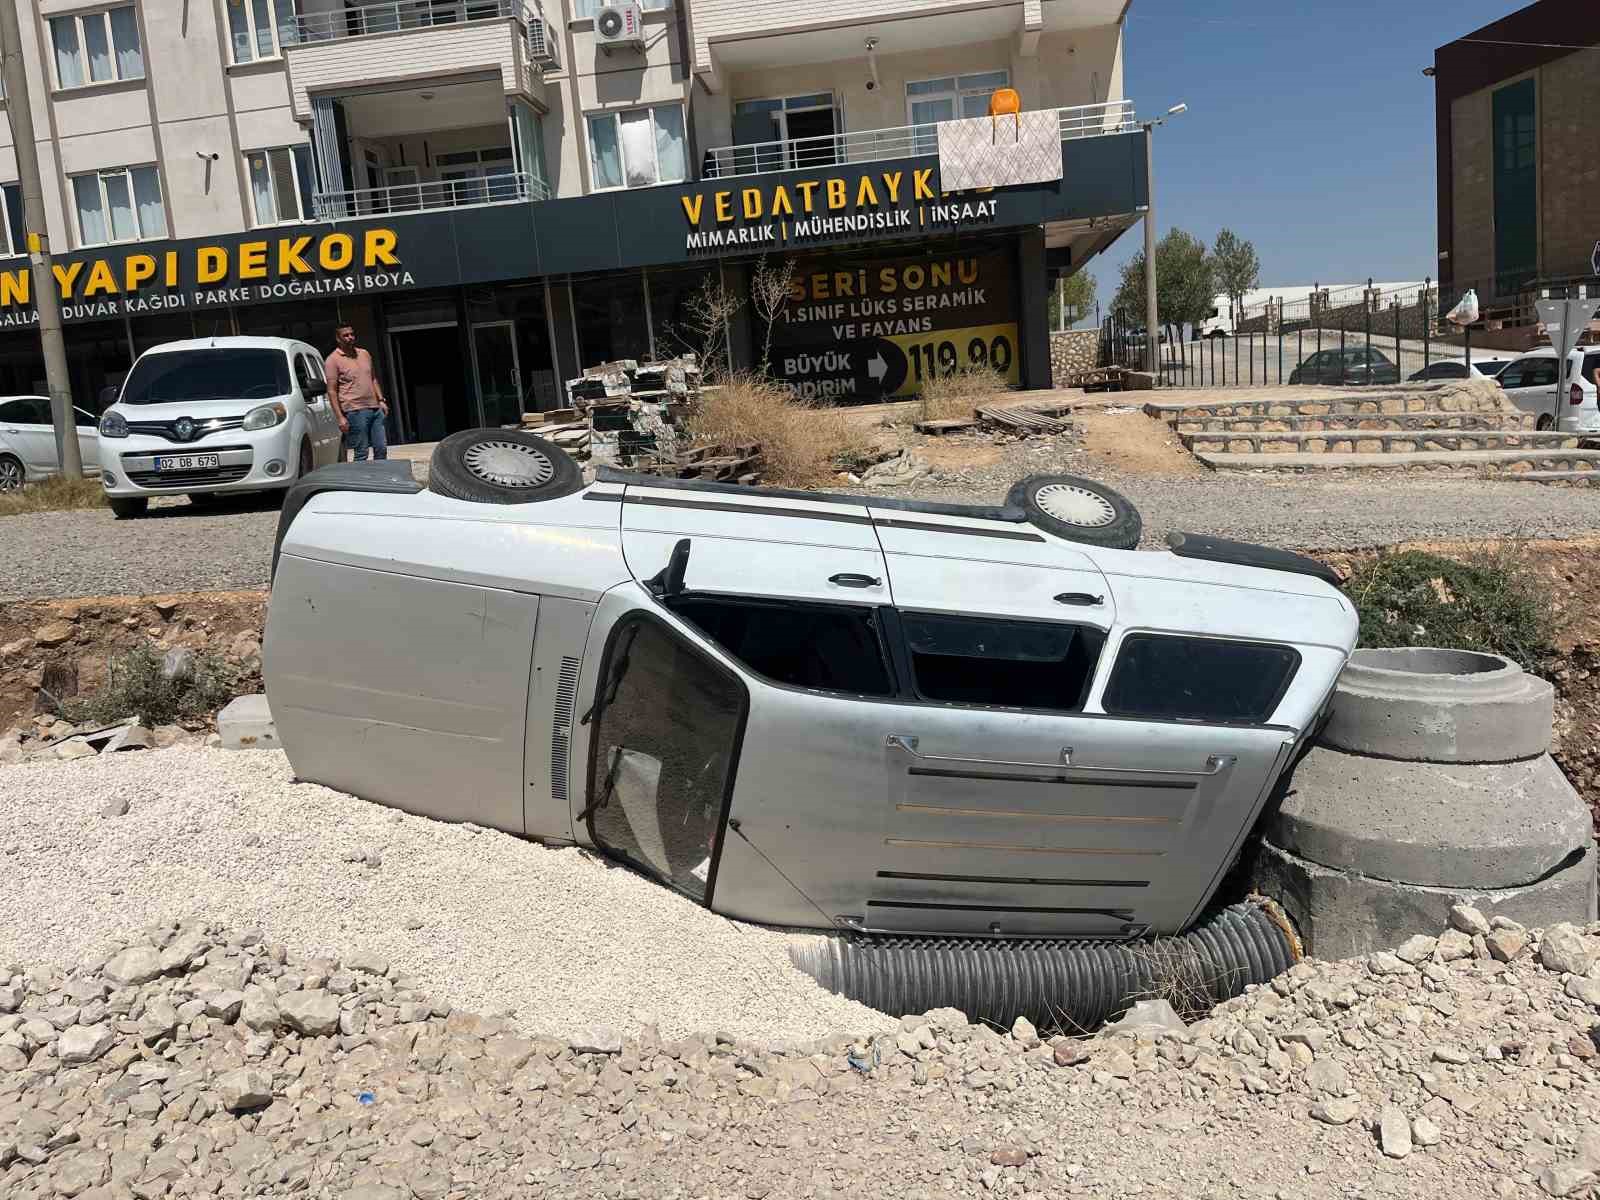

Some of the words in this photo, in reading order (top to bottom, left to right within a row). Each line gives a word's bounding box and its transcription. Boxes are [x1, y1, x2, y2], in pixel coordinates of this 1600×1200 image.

[681, 167, 993, 225] VEDATBAYK
[686, 224, 775, 249] MİMARLIK
[795, 209, 911, 237] MÜHENDİSLİK
[931, 199, 997, 224] İNŞAAT
[52, 251, 177, 299] YAPI
[197, 228, 401, 284] DEKOR
[879, 257, 978, 293] SONU
[62, 301, 119, 320] DUVAR
[126, 294, 185, 313] KAĞIDI
[195, 287, 250, 305] PARKE
[260, 277, 355, 299] DOĞALTAŞ
[364, 271, 415, 288] BOYA
[850, 298, 897, 317] LÜKS
[903, 287, 986, 312] SERAMİK
[832, 324, 856, 341] VE
[862, 316, 932, 337] FAYANS
[784, 351, 851, 375] BÜYÜK
[161, 458, 174, 469] 02
[198, 456, 217, 467] 679
